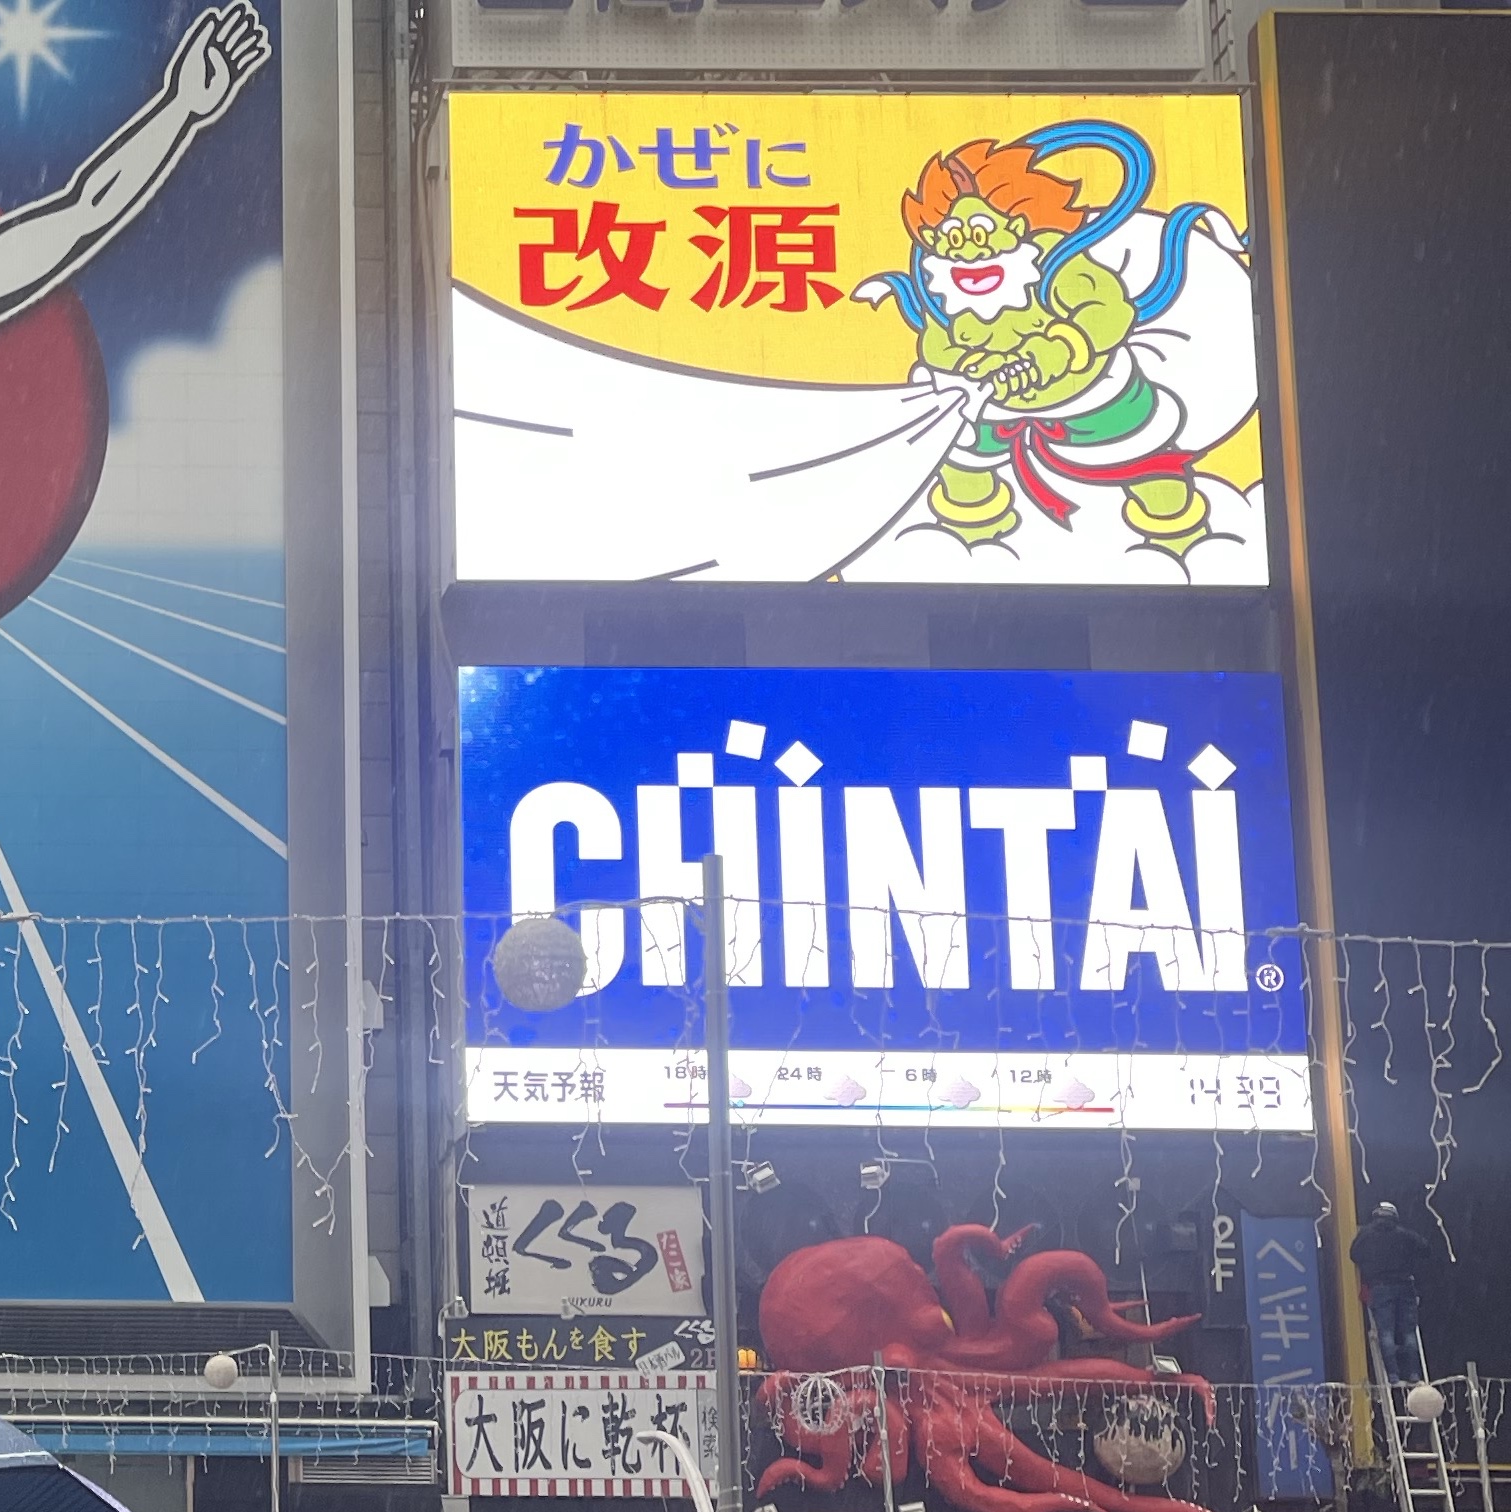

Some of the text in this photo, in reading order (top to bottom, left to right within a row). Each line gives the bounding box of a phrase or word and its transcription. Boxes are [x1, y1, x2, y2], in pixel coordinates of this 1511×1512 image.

[542, 122, 812, 191] かぜに
[513, 201, 852, 313] 改源
[510, 718, 1248, 1000] CHINTAI
[493, 1070, 606, 1104] 天気予報
[481, 1196, 510, 1299] 道頓堀
[512, 1199, 658, 1295] くくる
[450, 1325, 647, 1361] 大阪もんを食す
[464, 1391, 691, 1476] 大阪に乾杯
[701, 1406, 719, 1459] 検索
